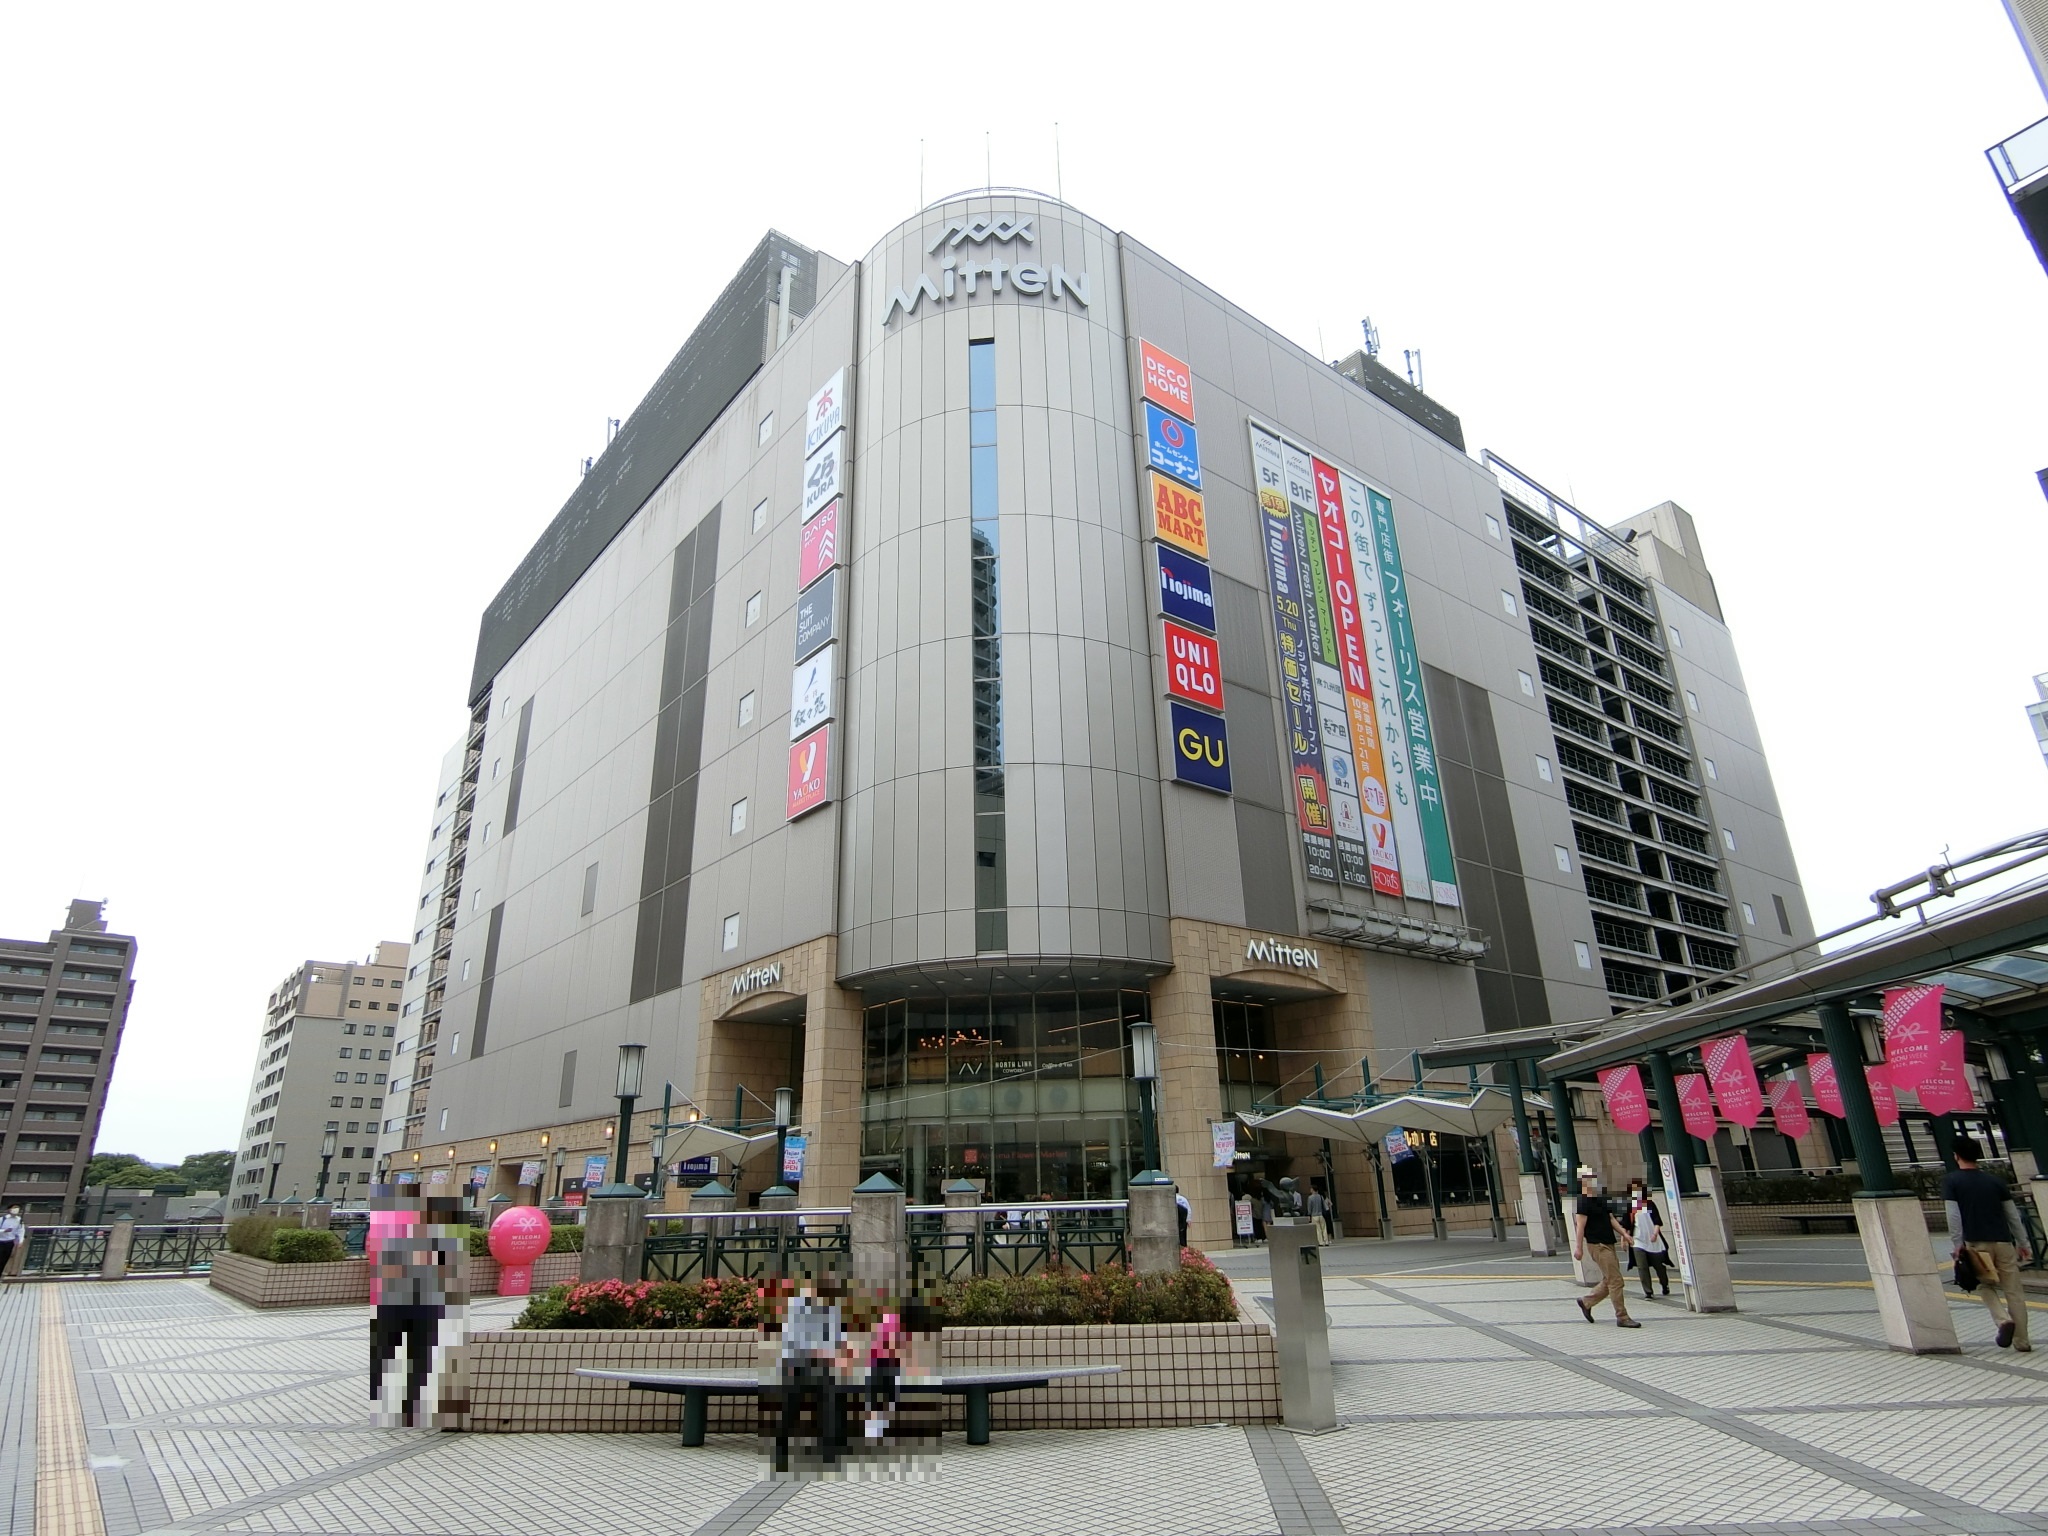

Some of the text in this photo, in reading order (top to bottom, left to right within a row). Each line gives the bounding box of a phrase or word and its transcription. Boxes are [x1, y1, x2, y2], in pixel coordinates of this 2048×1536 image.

[881, 254, 1092, 327] MitteN
[1145, 355, 1188, 389] DECO
[1147, 371, 1190, 405] HOME
[807, 405, 841, 451] KIKUYA
[1151, 447, 1199, 481] コーナン
[1154, 440, 1195, 464] ホームセンター
[806, 476, 835, 509] KURA
[1262, 466, 1279, 487] 5F
[1290, 481, 1313, 503] B1F
[1156, 483, 1203, 527] ABC
[804, 509, 835, 541] DAISO
[1157, 510, 1205, 547] MART
[1300, 561, 1314, 599] Fresh
[799, 602, 814, 621] THE
[1276, 595, 1299, 617] 5.20
[797, 612, 832, 646] COMPANY
[798, 613, 815, 633] SUIT
[1281, 616, 1298, 632] Thu
[1306, 602, 1321, 657] Market
[1320, 606, 1332, 654] マーケット
[1172, 635, 1209, 669] UNI
[1175, 663, 1215, 696] QLO
[1279, 631, 1309, 755] 特価セール
[1297, 639, 1318, 755] ノジマ先行オープン
[1350, 696, 1370, 774] 10時から21時
[1361, 701, 1376, 750] 営業時間
[1178, 727, 1224, 768] GU
[792, 777, 821, 801] YAOKO
[1302, 832, 1331, 848] 営業時間
[1308, 845, 1331, 860] 10:00
[1371, 848, 1395, 862] YAOKO
[1308, 863, 1334, 878] 20:00
[1341, 852, 1364, 866] 10:00
[1343, 870, 1366, 884] 21:00
[1246, 936, 1319, 970] MitteN
[729, 960, 783, 997] MitteN
[995, 1060, 1033, 1068] NORTH LINK
[1890, 1044, 1929, 1056] WELCOME
[1909, 1051, 1929, 1061] WEEK
[1614, 1103, 1643, 1112] WELCOME
